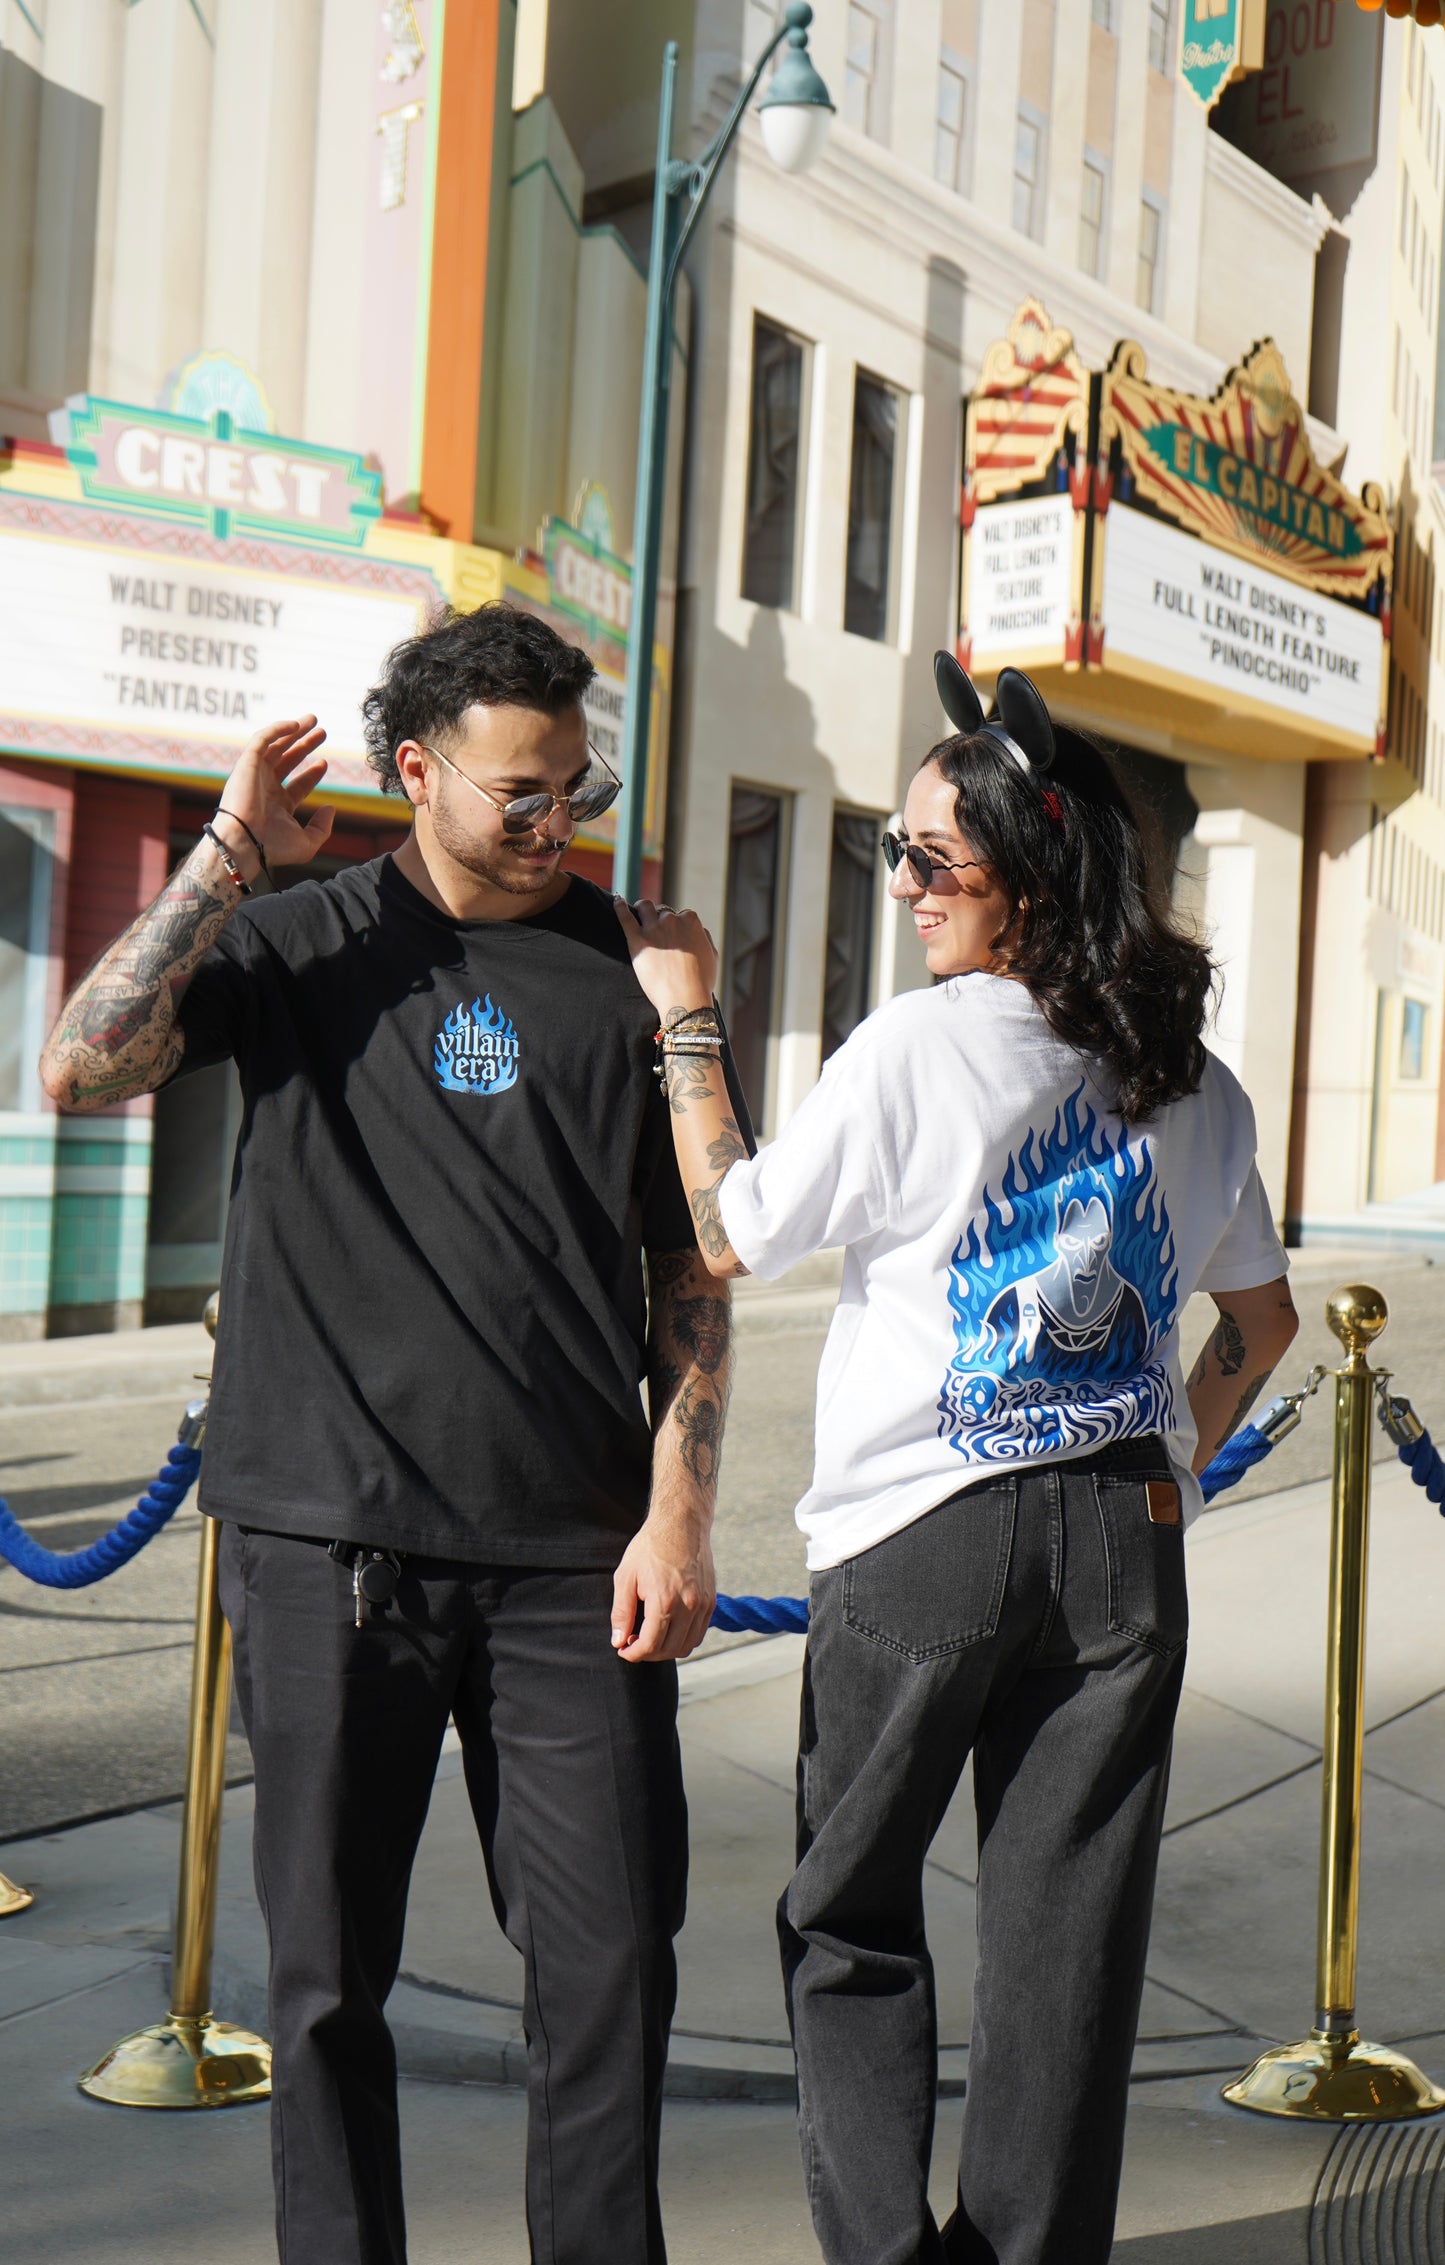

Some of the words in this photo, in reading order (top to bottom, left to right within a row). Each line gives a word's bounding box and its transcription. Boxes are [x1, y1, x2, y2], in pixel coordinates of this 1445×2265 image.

[115, 428, 331, 517] CREST
[1174, 430, 1209, 483] EL
[1217, 455, 1345, 550] CAPITAN
[109, 573, 176, 613] WALT
[187, 585, 283, 628] DISNEY
[560, 545, 632, 627] CREST
[1201, 562, 1245, 600] WALT
[1250, 586, 1326, 637] DISNEY'S
[120, 625, 258, 673] PRESENTS
[1153, 580, 1196, 619] FULL
[1205, 602, 1274, 649] LENGTH
[1282, 633, 1361, 682] FEATURE
[1200, 632, 1320, 694] "PINOCCHIO"
[103, 672, 265, 720] "FANTASIA"
[437, 1024, 520, 1058] villain
[455, 1056, 497, 1081] era
